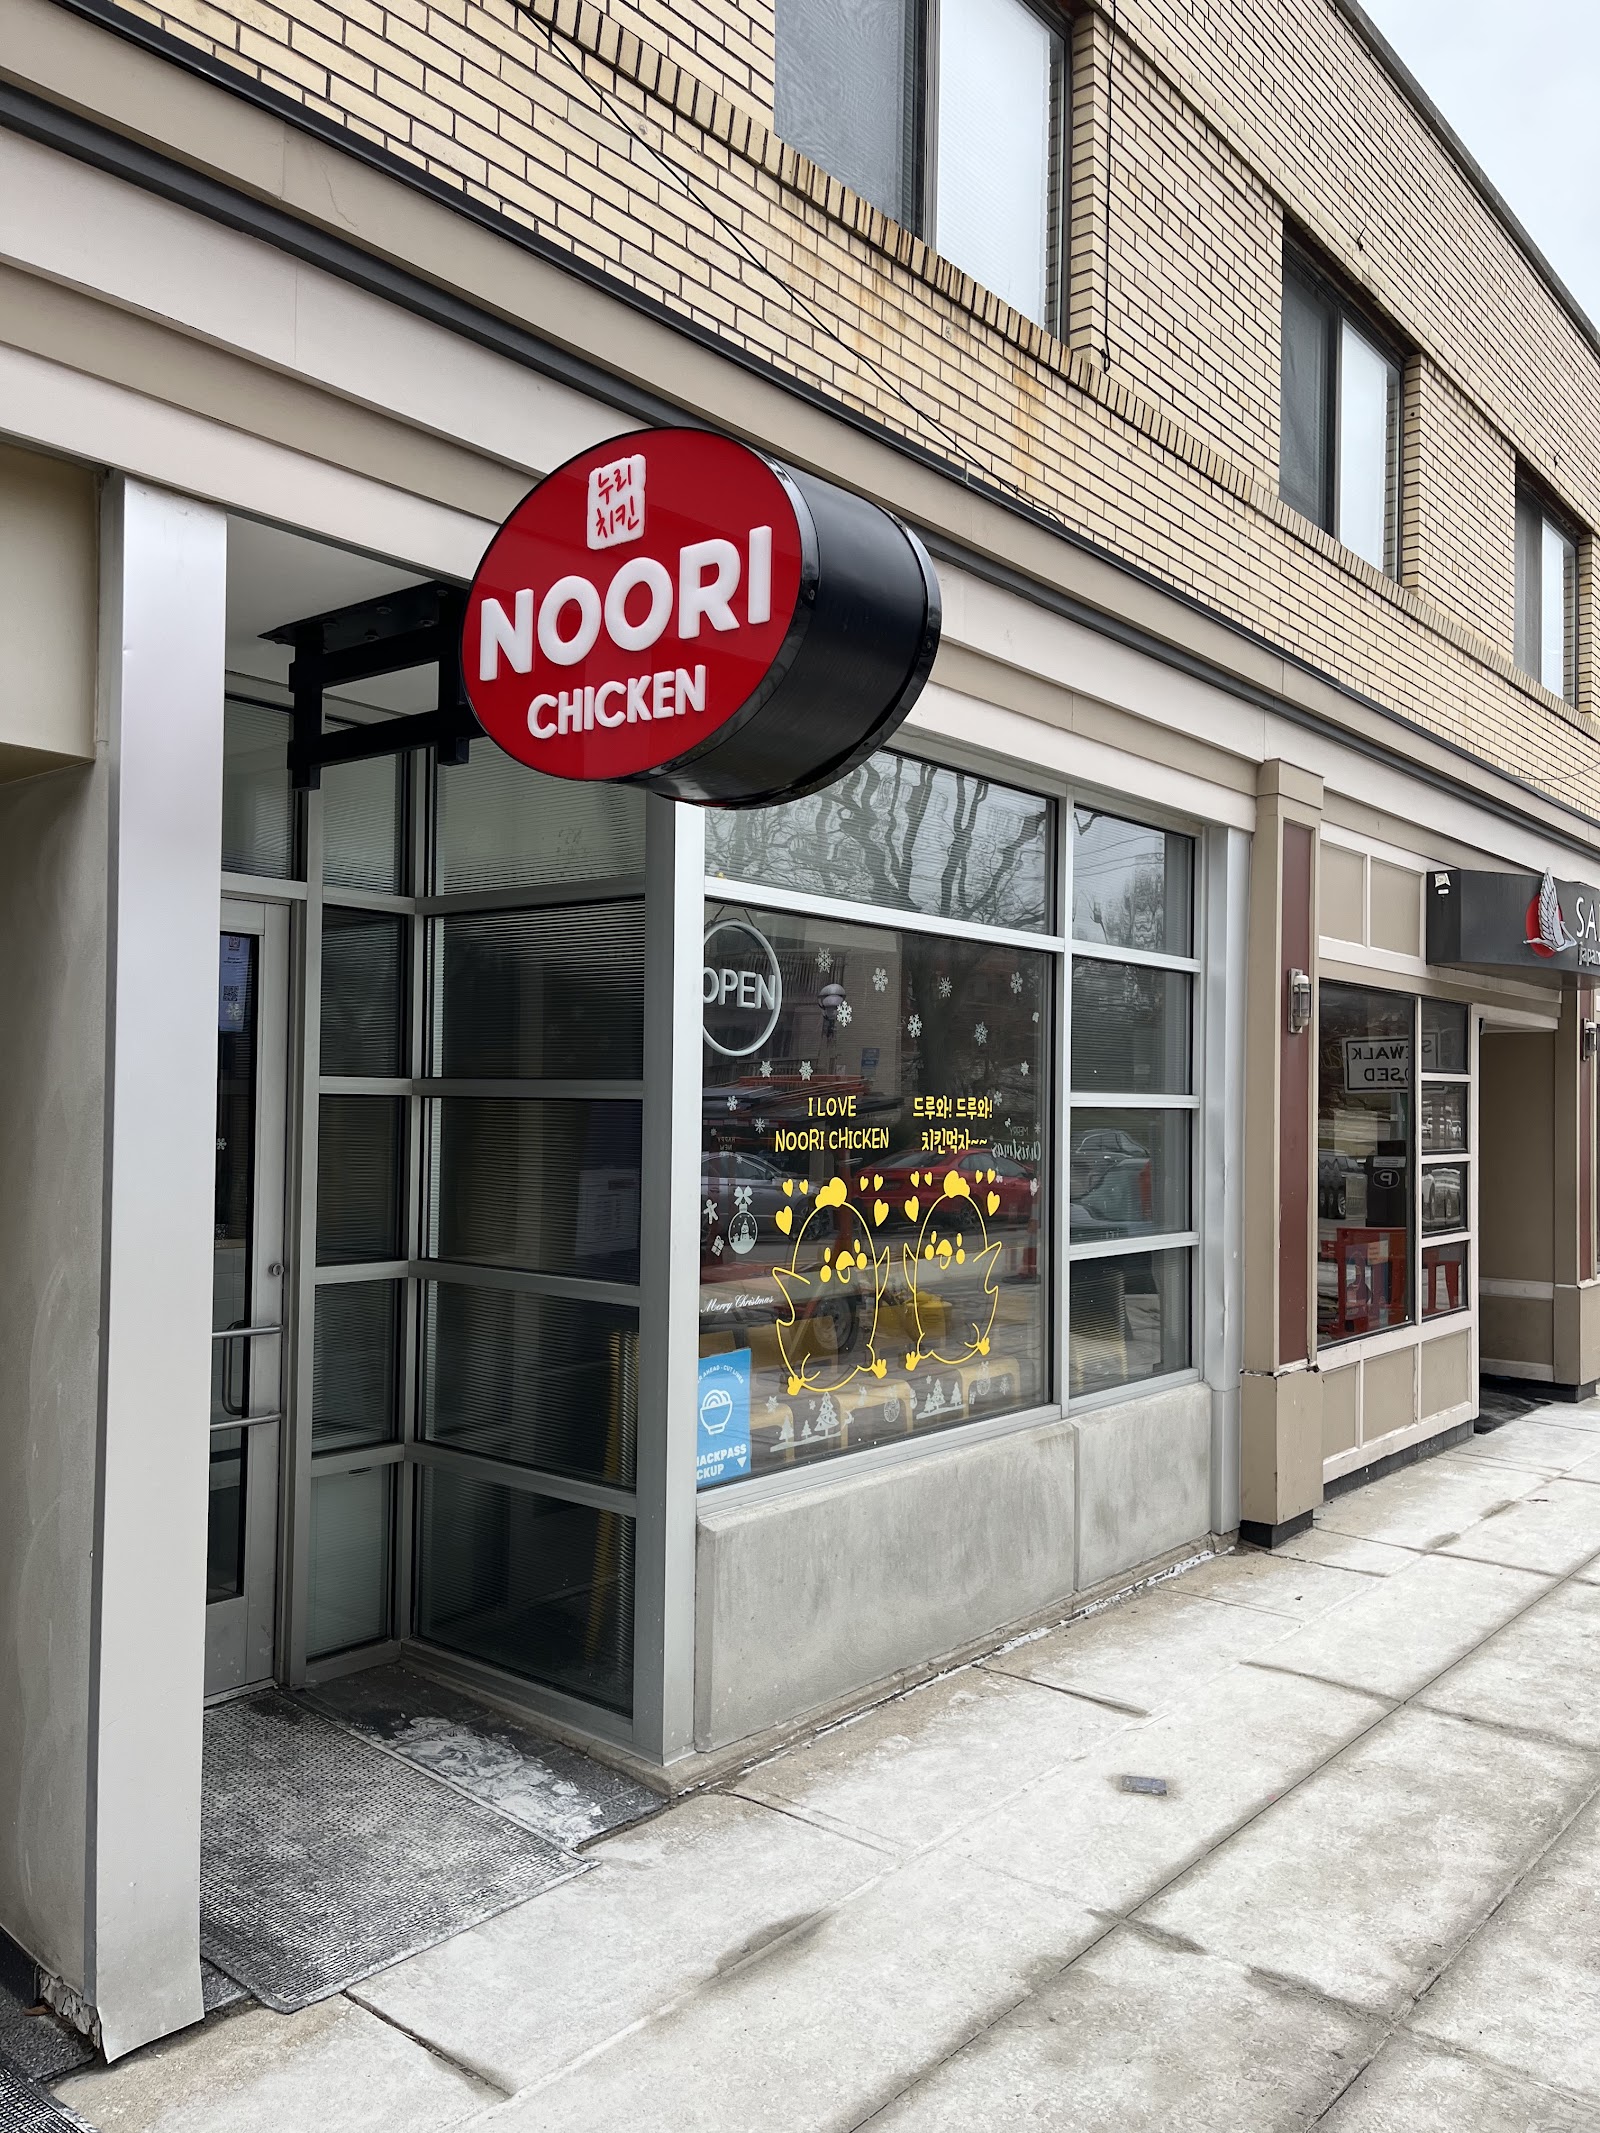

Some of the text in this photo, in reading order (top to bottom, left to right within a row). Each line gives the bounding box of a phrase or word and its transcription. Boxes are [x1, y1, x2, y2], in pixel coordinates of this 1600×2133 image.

[597, 464, 632, 505] 누리
[596, 495, 640, 539] 치킨
[479, 525, 773, 681] NOORI
[527, 664, 707, 740] CHICKEN
[1576, 896, 1600, 943] SA
[703, 966, 776, 1011] OPEN
[808, 1095, 857, 1117] I LOVE
[913, 1095, 993, 1120] 드루와! 드루와!
[775, 1127, 889, 1152] NOORI CHICKEN
[921, 1127, 988, 1154] 치킨먹자~~
[700, 1294, 775, 1314] Merry Christmas
